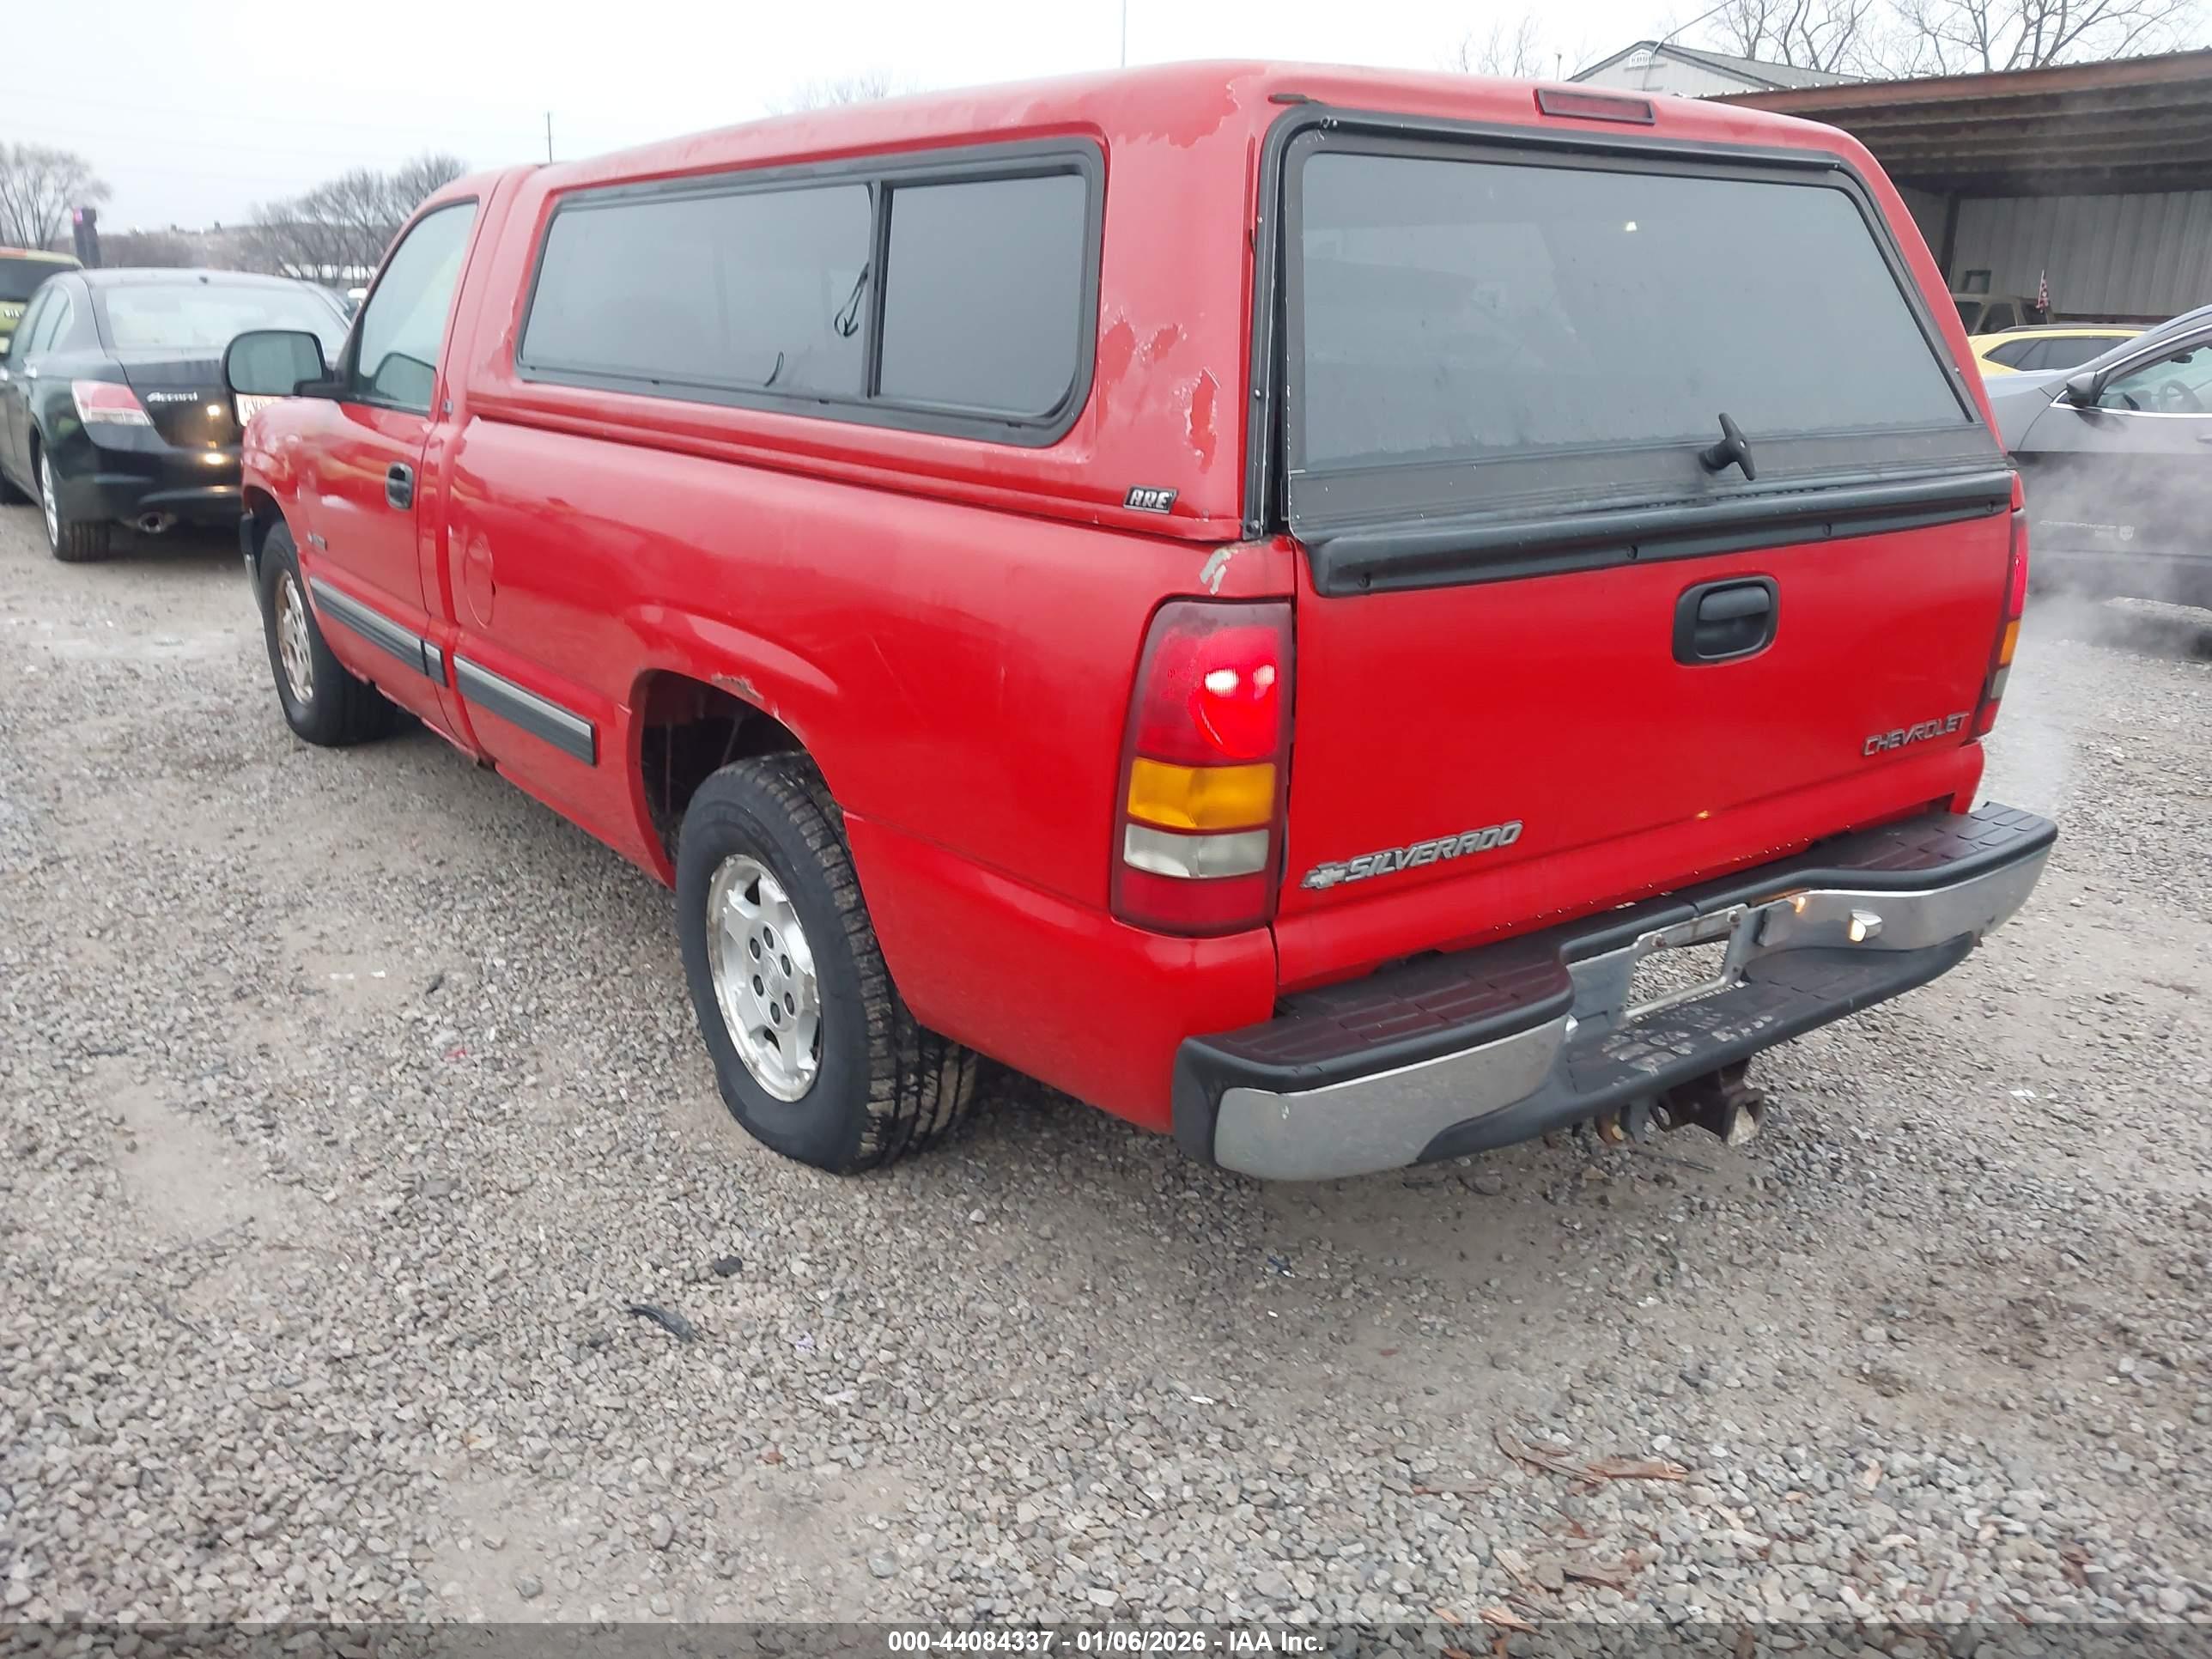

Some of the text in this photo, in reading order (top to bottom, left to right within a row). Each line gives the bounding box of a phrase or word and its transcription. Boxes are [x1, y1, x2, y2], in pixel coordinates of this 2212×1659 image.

[1129, 489, 1170, 508] ARE
[1863, 712, 1970, 757] CHEVROLET
[1345, 819, 1524, 883] SILVERADO
